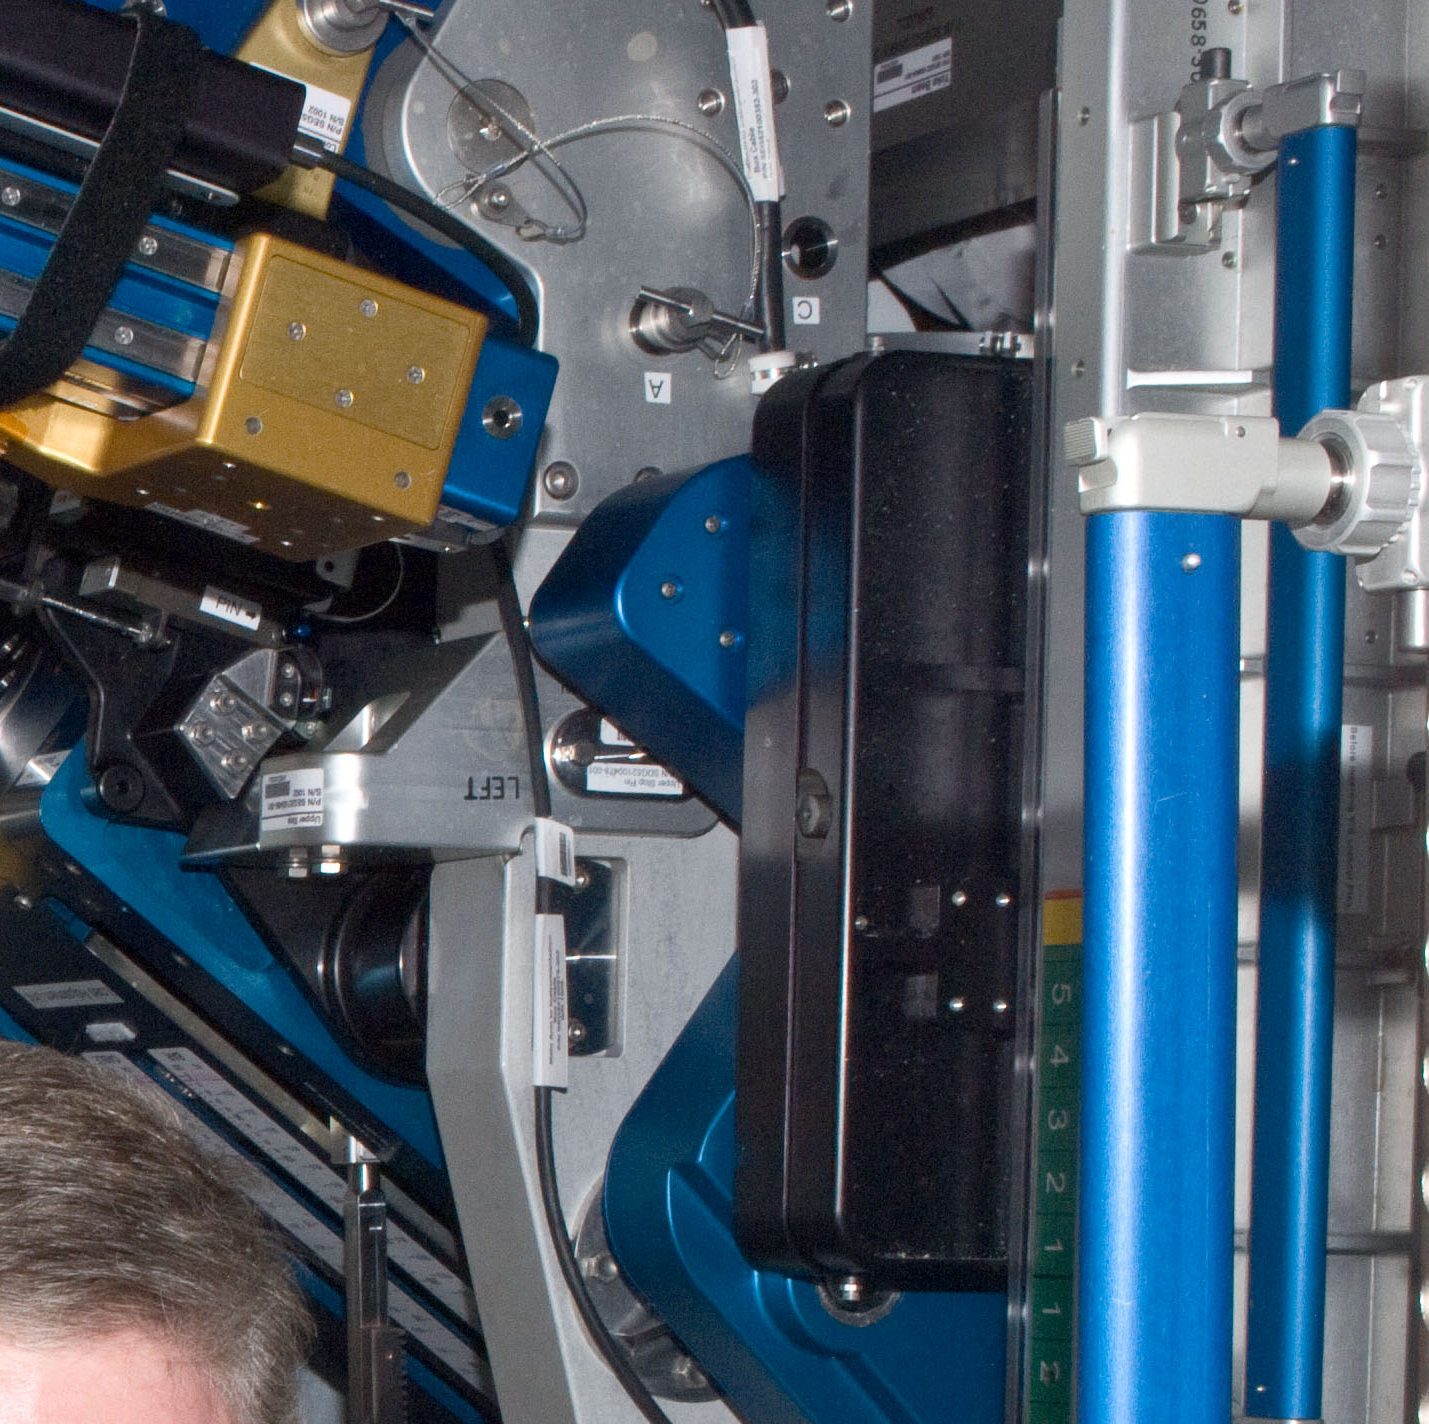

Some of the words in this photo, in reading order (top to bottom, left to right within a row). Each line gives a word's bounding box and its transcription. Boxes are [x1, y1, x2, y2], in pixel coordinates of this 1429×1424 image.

[798, 300, 813, 320] C
[648, 379, 664, 399] A
[215, 596, 241, 616] PIN
[464, 776, 520, 800] LEFT
[1052, 983, 1071, 1005] 5
[1050, 1045, 1070, 1068] 4
[1047, 1109, 1068, 1131] 3
[1046, 1172, 1065, 1193] 2
[1044, 1239, 1063, 1251] 1
[1042, 1302, 1061, 1314] 1
